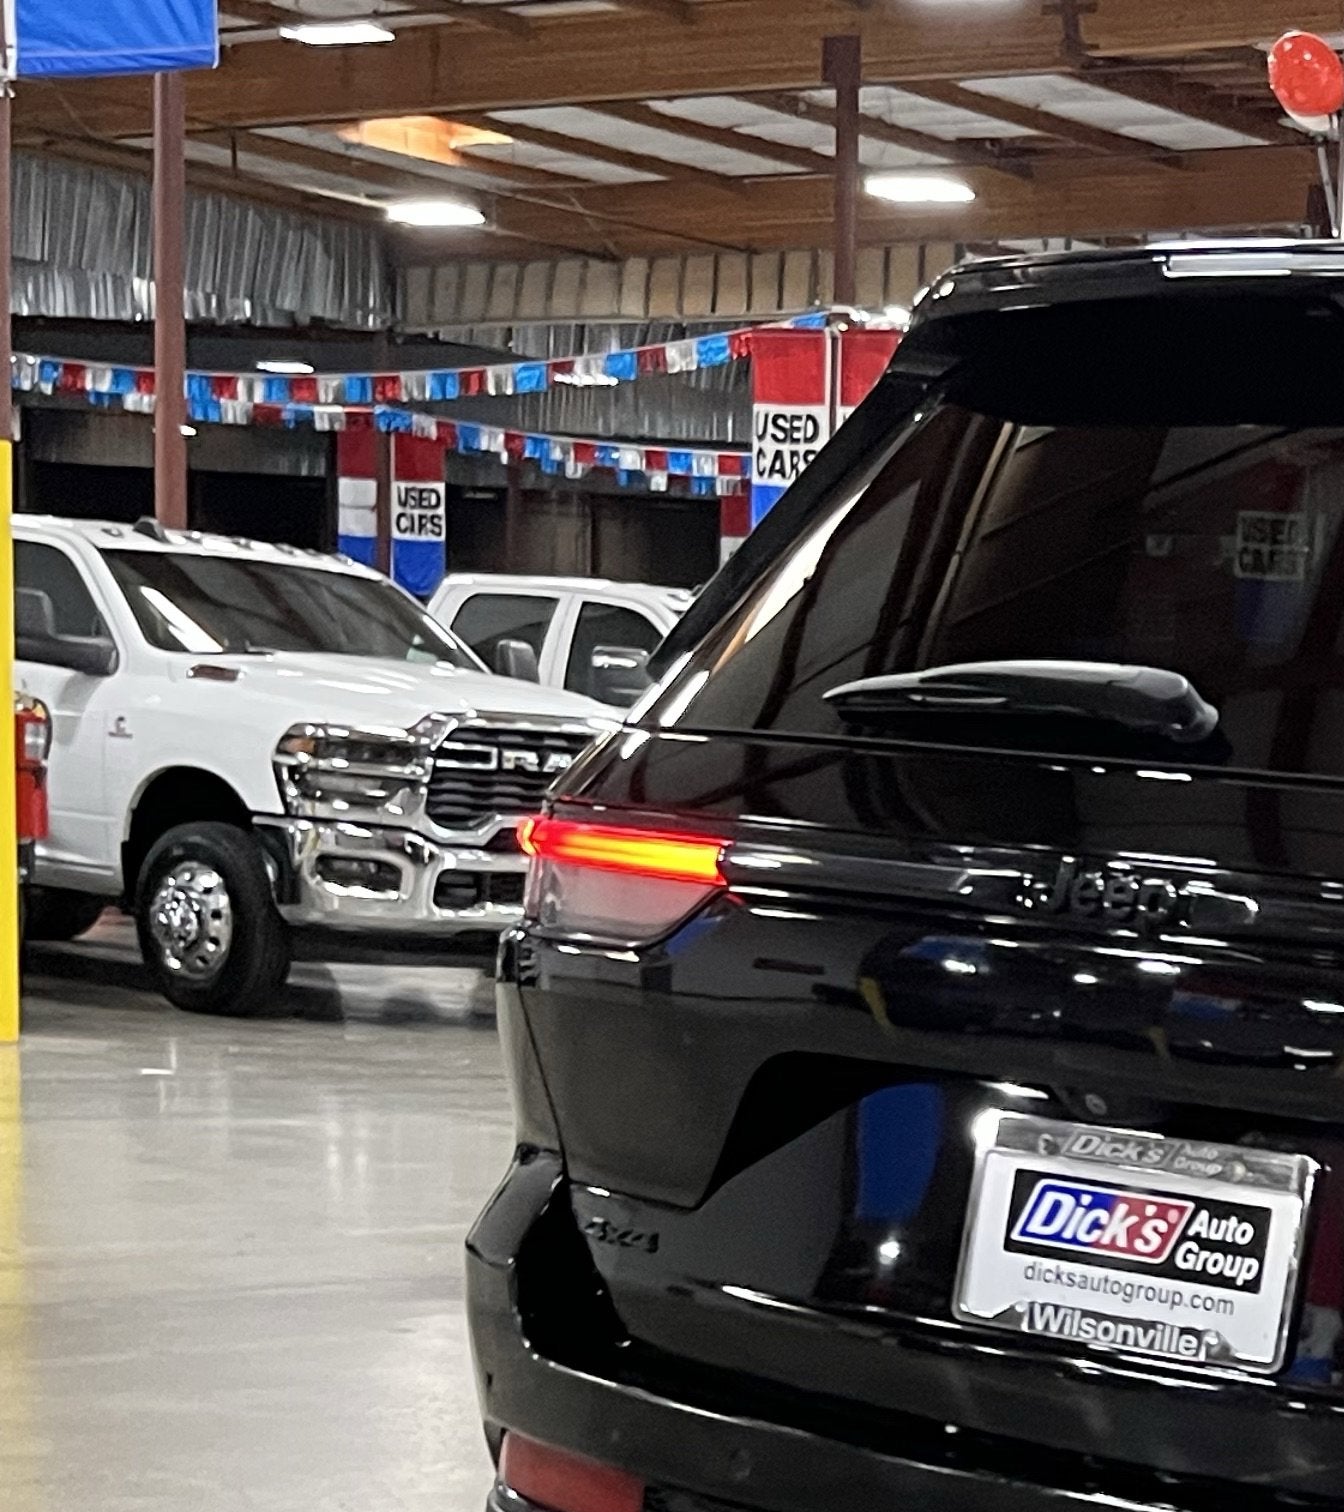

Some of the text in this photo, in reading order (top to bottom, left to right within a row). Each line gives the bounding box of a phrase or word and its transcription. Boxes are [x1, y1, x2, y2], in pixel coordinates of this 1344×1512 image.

[756, 412, 819, 443] USED
[397, 487, 441, 510] USED
[1188, 1209, 1255, 1246] Auto
[1174, 1240, 1259, 1286] Group
[1023, 1261, 1235, 1316] dicksautogroup.com
[1030, 1302, 1199, 1358] Wilsonville
